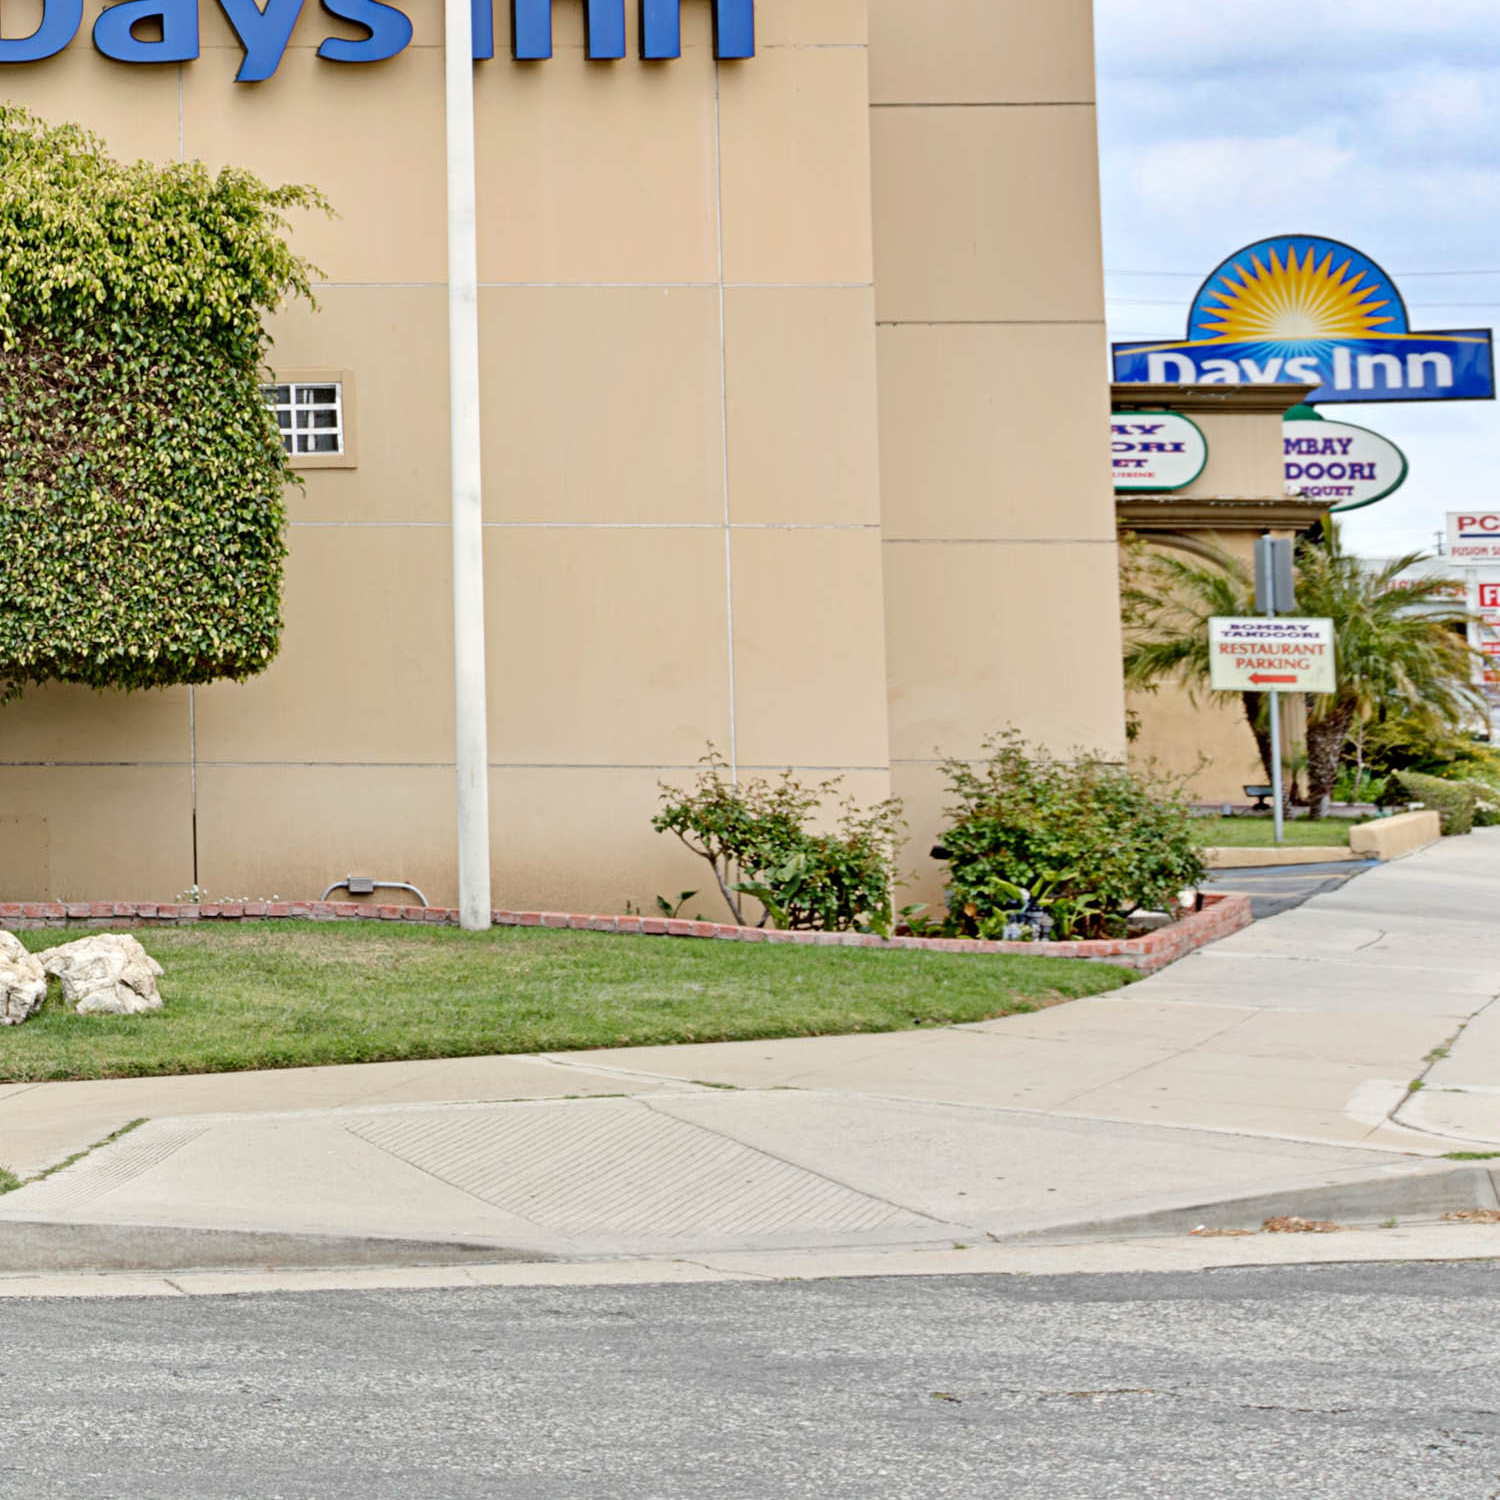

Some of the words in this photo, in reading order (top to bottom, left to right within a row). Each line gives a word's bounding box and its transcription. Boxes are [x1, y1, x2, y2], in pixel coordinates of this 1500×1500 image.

[1333, 347, 1454, 391] Inn
[1284, 462, 1377, 480] DOORI
[1229, 623, 1310, 631] BOMBAY
[1221, 630, 1320, 638] TANDOORI
[1219, 643, 1326, 655] RESTAURANT
[1235, 658, 1310, 670] PARKING
